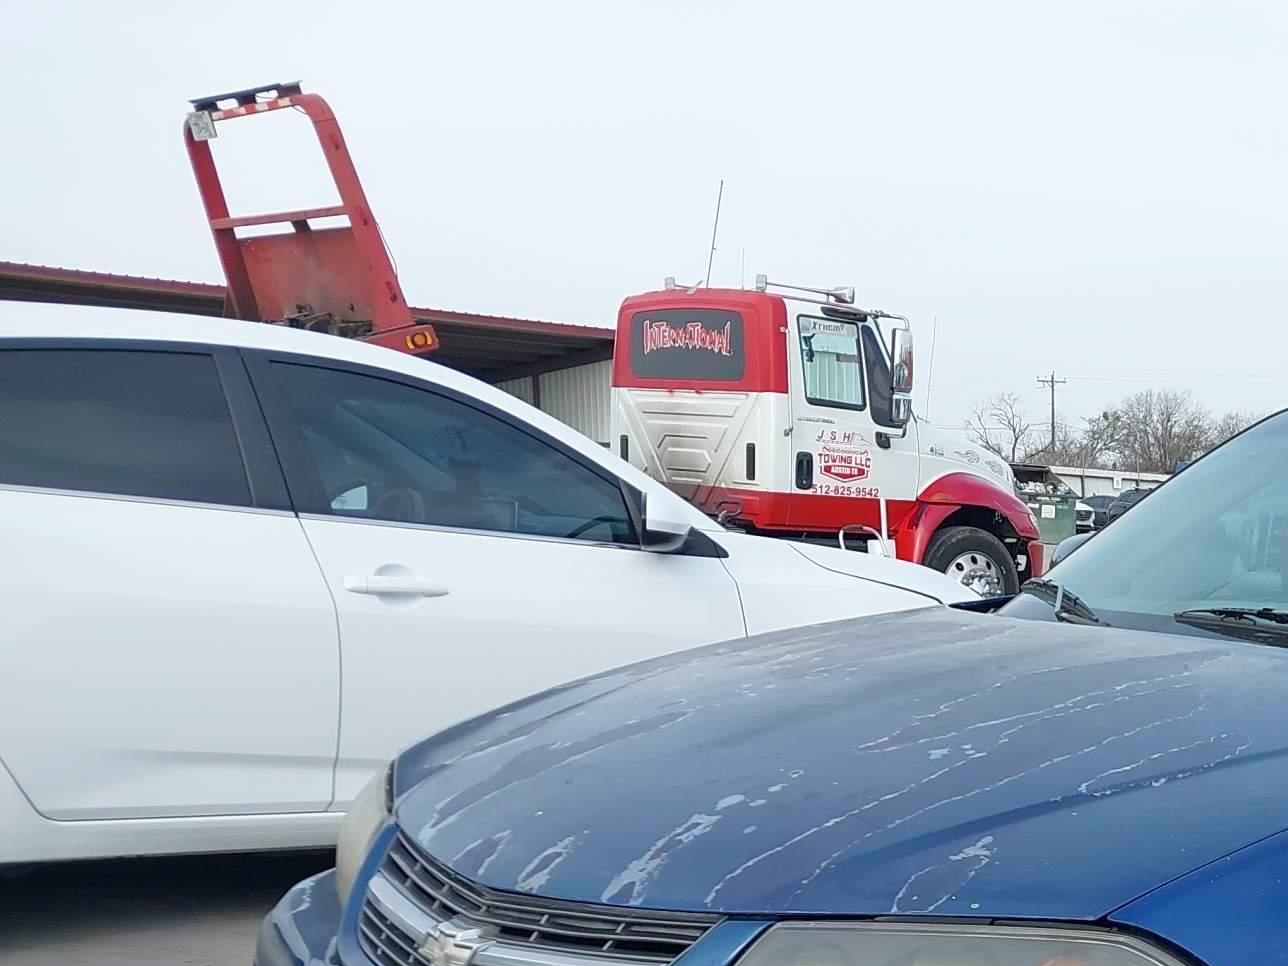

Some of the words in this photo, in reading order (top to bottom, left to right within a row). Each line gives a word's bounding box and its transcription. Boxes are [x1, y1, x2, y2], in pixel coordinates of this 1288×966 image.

[818, 453, 852, 465] TOWING
[854, 456, 871, 468] LLC
[812, 484, 879, 498] 512-825-9542
